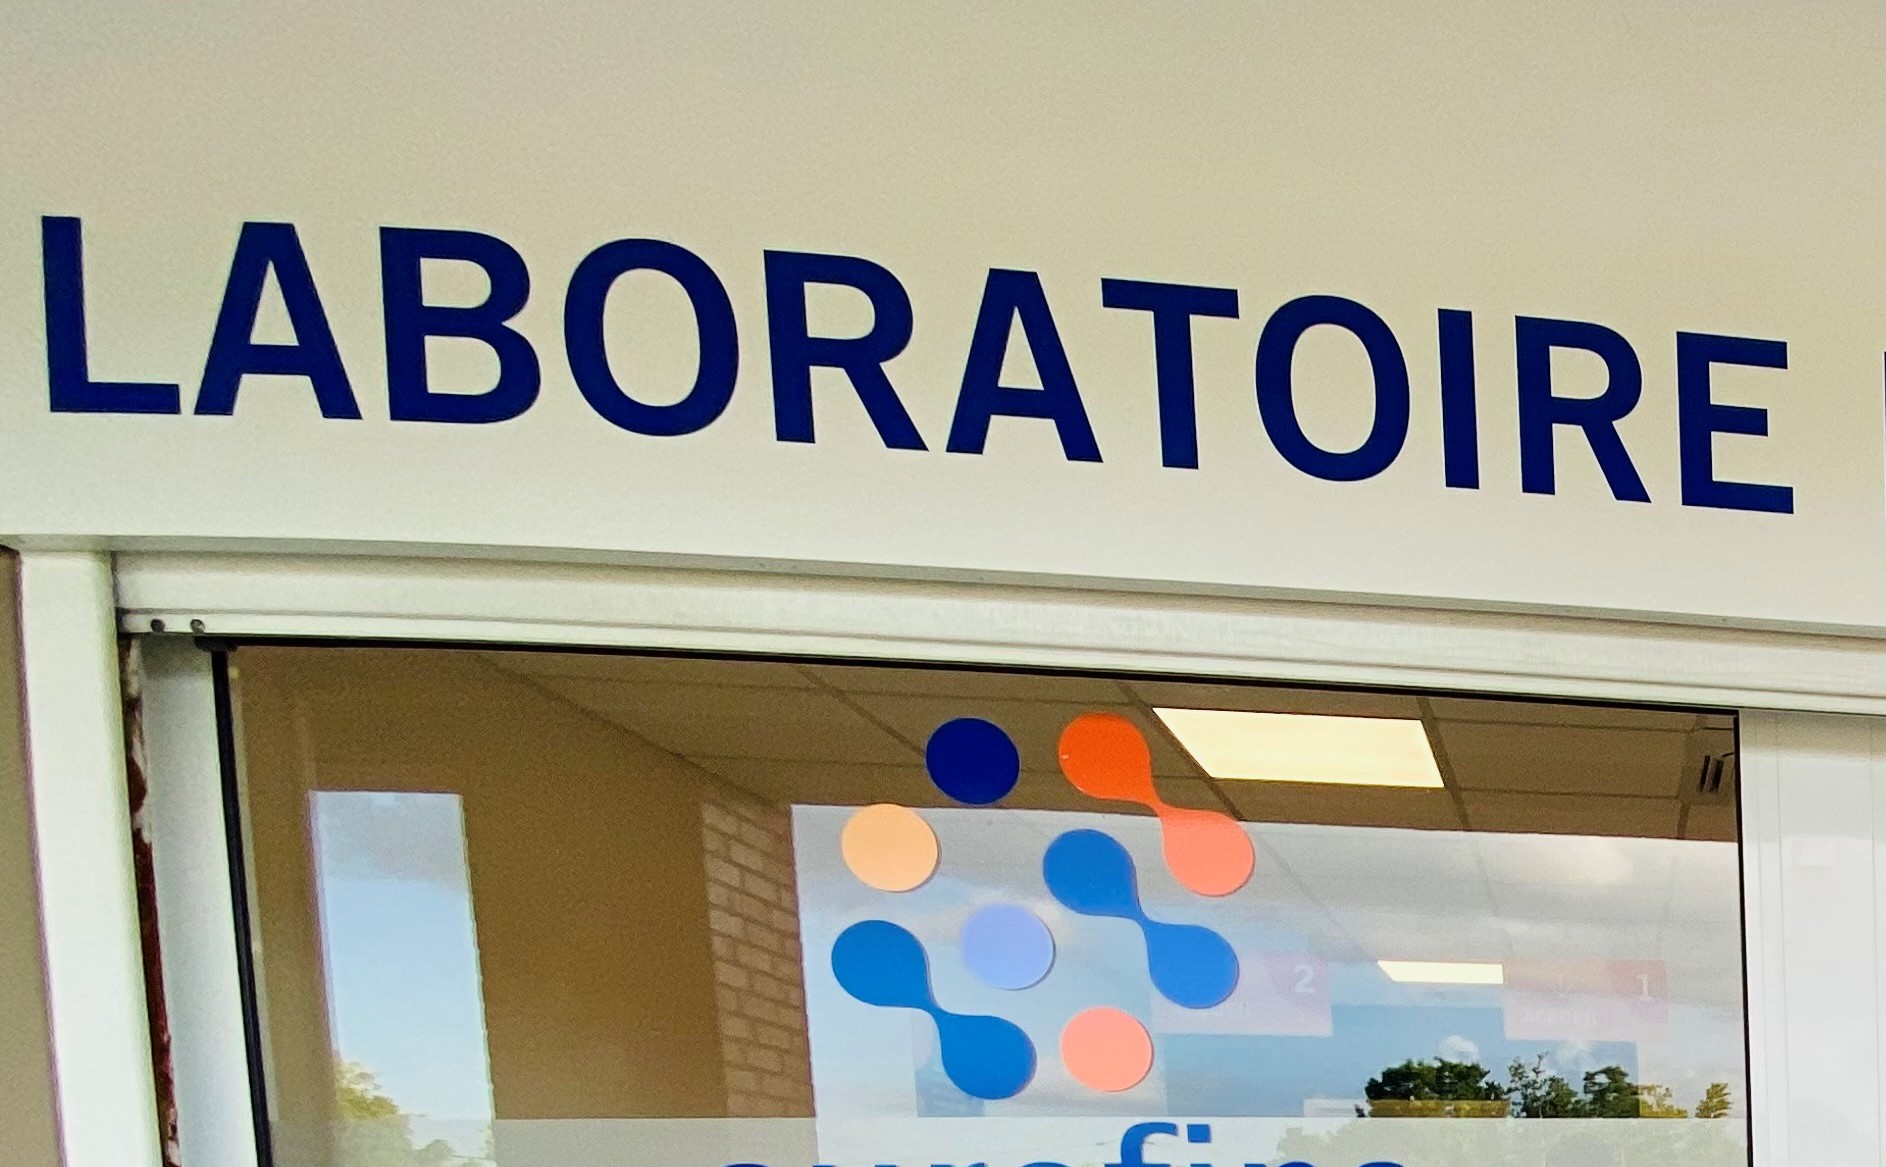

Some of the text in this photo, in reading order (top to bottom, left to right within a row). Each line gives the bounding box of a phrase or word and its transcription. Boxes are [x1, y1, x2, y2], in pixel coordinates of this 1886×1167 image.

[41, 214, 1795, 515] LABORATOIRE
[1292, 963, 1316, 994] 2
[1636, 973, 1655, 1002] 1
